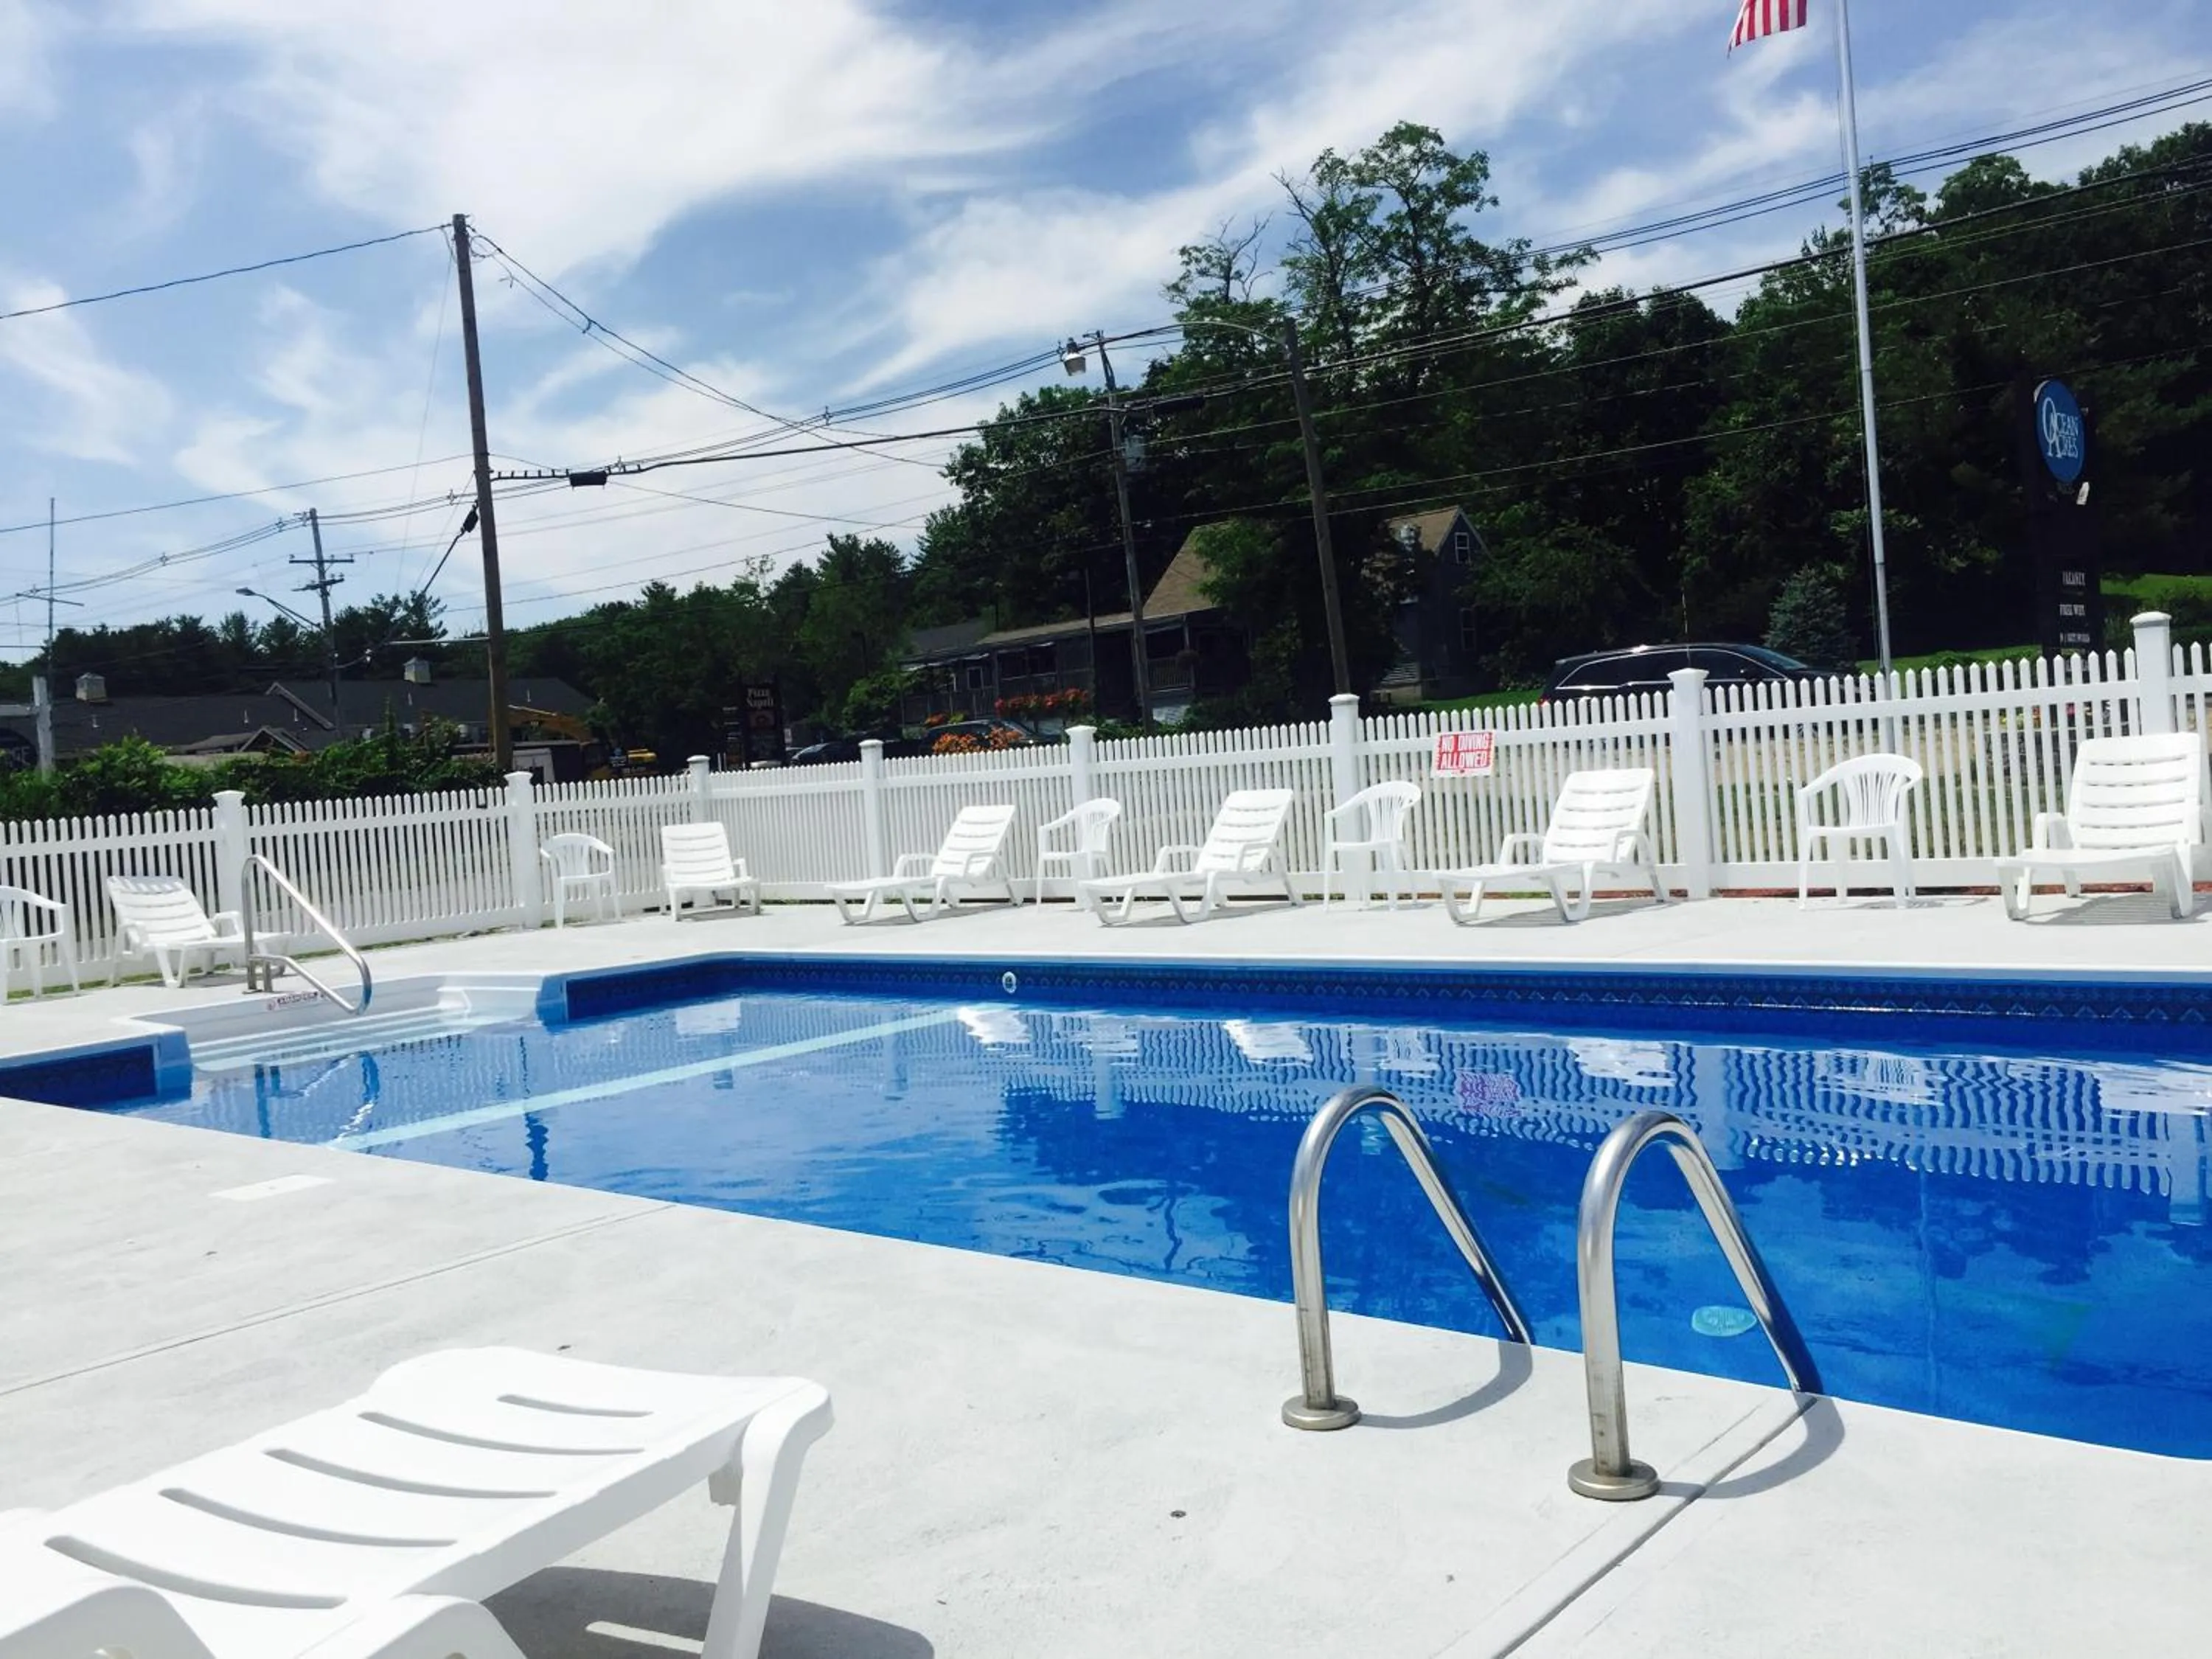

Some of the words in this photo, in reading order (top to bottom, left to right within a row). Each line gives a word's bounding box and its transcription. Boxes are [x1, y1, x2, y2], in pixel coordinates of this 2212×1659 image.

[2042, 397, 2079, 443] OCEAN
[2048, 411, 2079, 458] ACRES
[1441, 735, 1454, 751] NO
[1458, 734, 1489, 751] DIVING
[1440, 751, 1488, 768] ALLOWED
